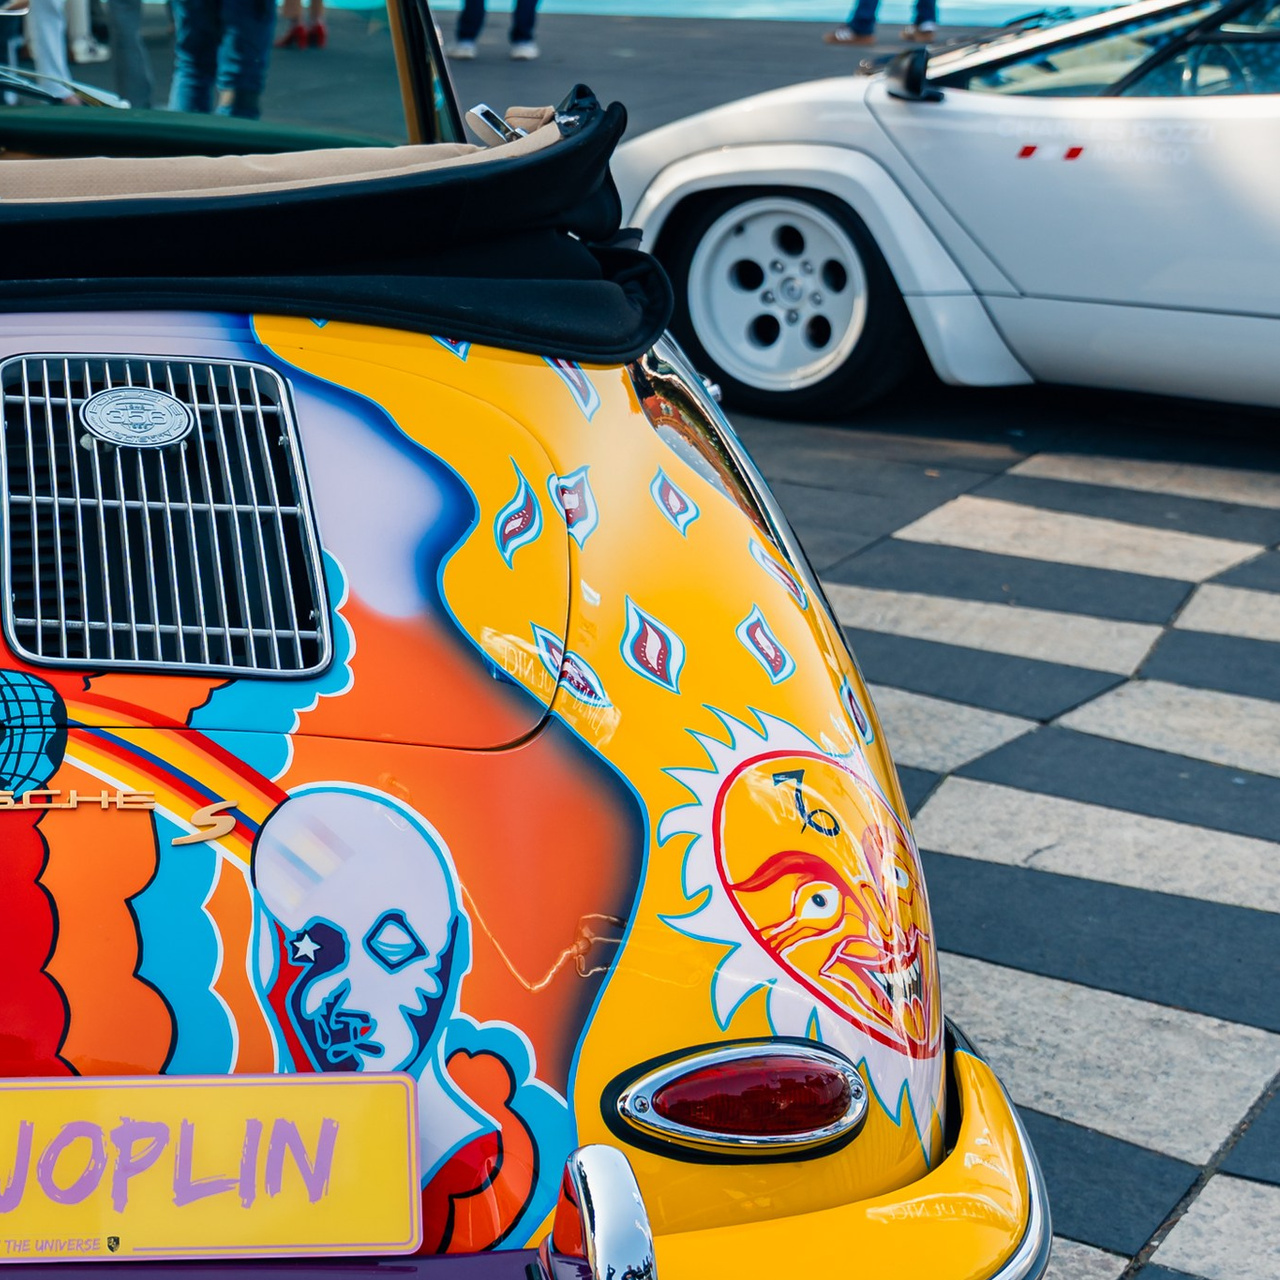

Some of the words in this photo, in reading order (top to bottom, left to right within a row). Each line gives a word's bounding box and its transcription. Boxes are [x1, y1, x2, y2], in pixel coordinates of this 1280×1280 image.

[106, 410, 168, 425] 356
[170, 800, 239, 846] S
[5, 1238, 31, 1253] THE
[35, 1237, 102, 1253] UNIVERSE
